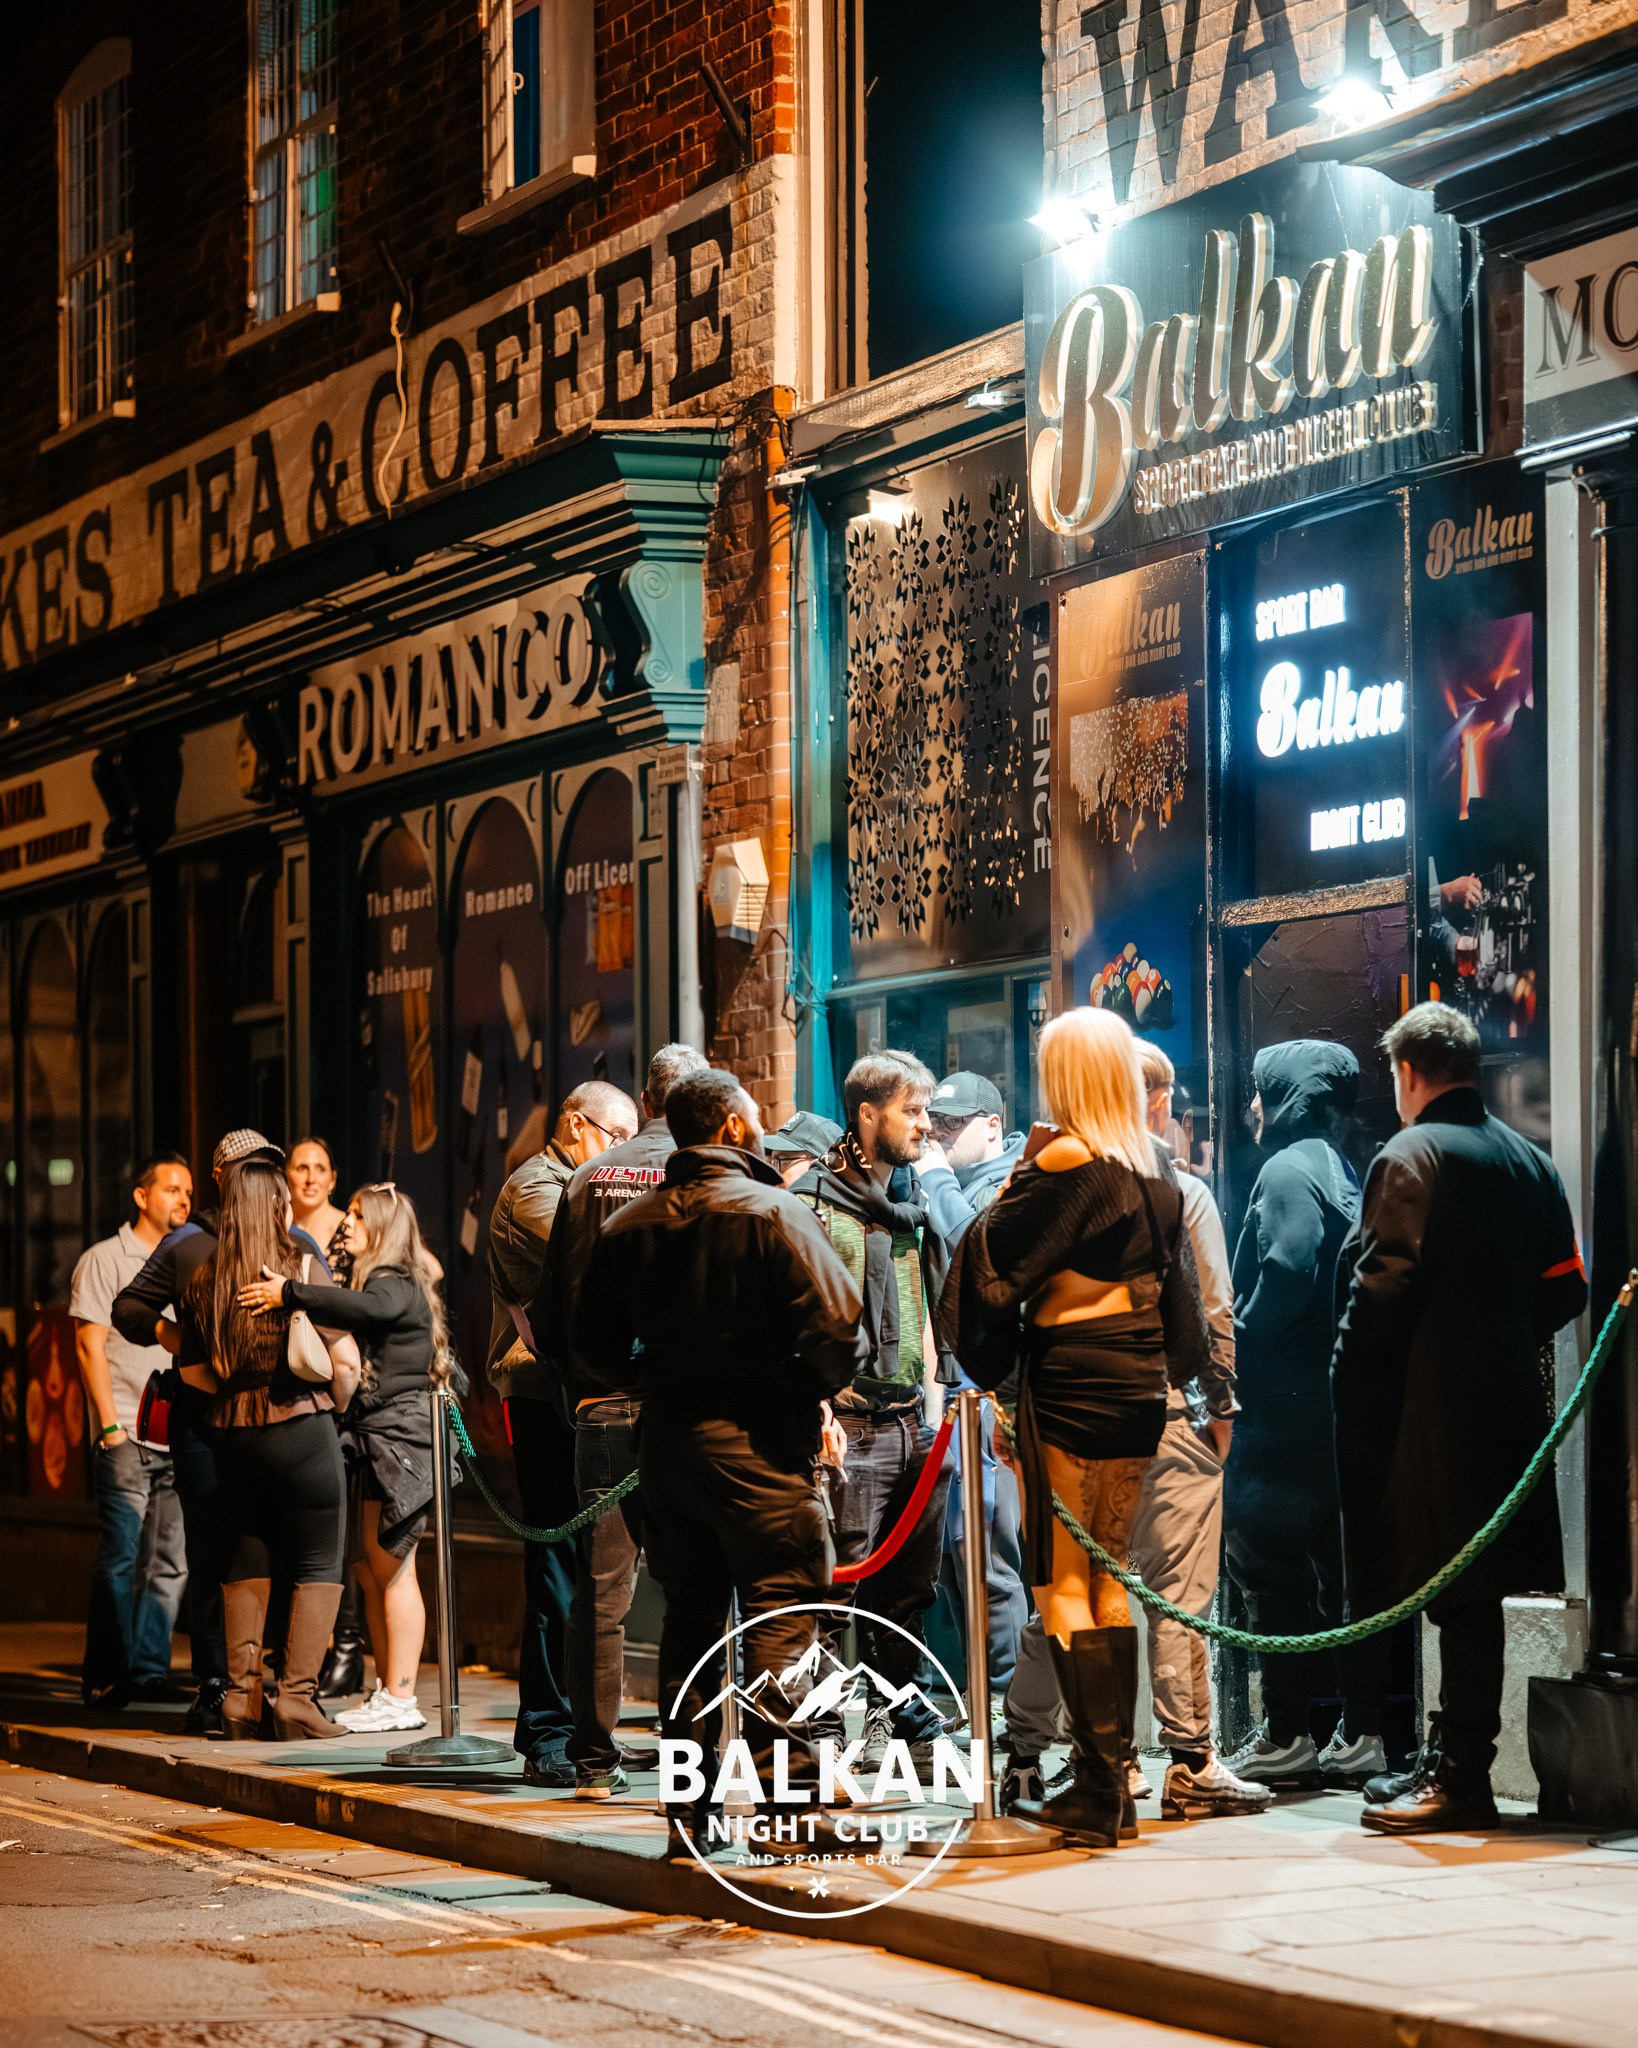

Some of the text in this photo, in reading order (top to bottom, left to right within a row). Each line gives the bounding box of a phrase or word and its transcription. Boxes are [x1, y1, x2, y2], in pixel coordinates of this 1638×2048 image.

[148, 430, 296, 600] TEA
[306, 421, 348, 540] &
[362, 204, 733, 516] COFFEE
[1031, 212, 1439, 537] Balkan
[1134, 380, 1438, 514] SPORT BAR AND NIGHT CLUB
[1425, 504, 1534, 580] Balkan
[1255, 582, 1346, 642] SPORT BAR
[298, 594, 595, 787] ROMANCO
[1256, 661, 1406, 758] Balkan
[1032, 633, 1051, 874] ICENCE
[1361, 796, 1406, 844] CLUB
[464, 882, 534, 919] Romanco
[563, 861, 592, 897] Off
[594, 1188, 603, 1197] 3
